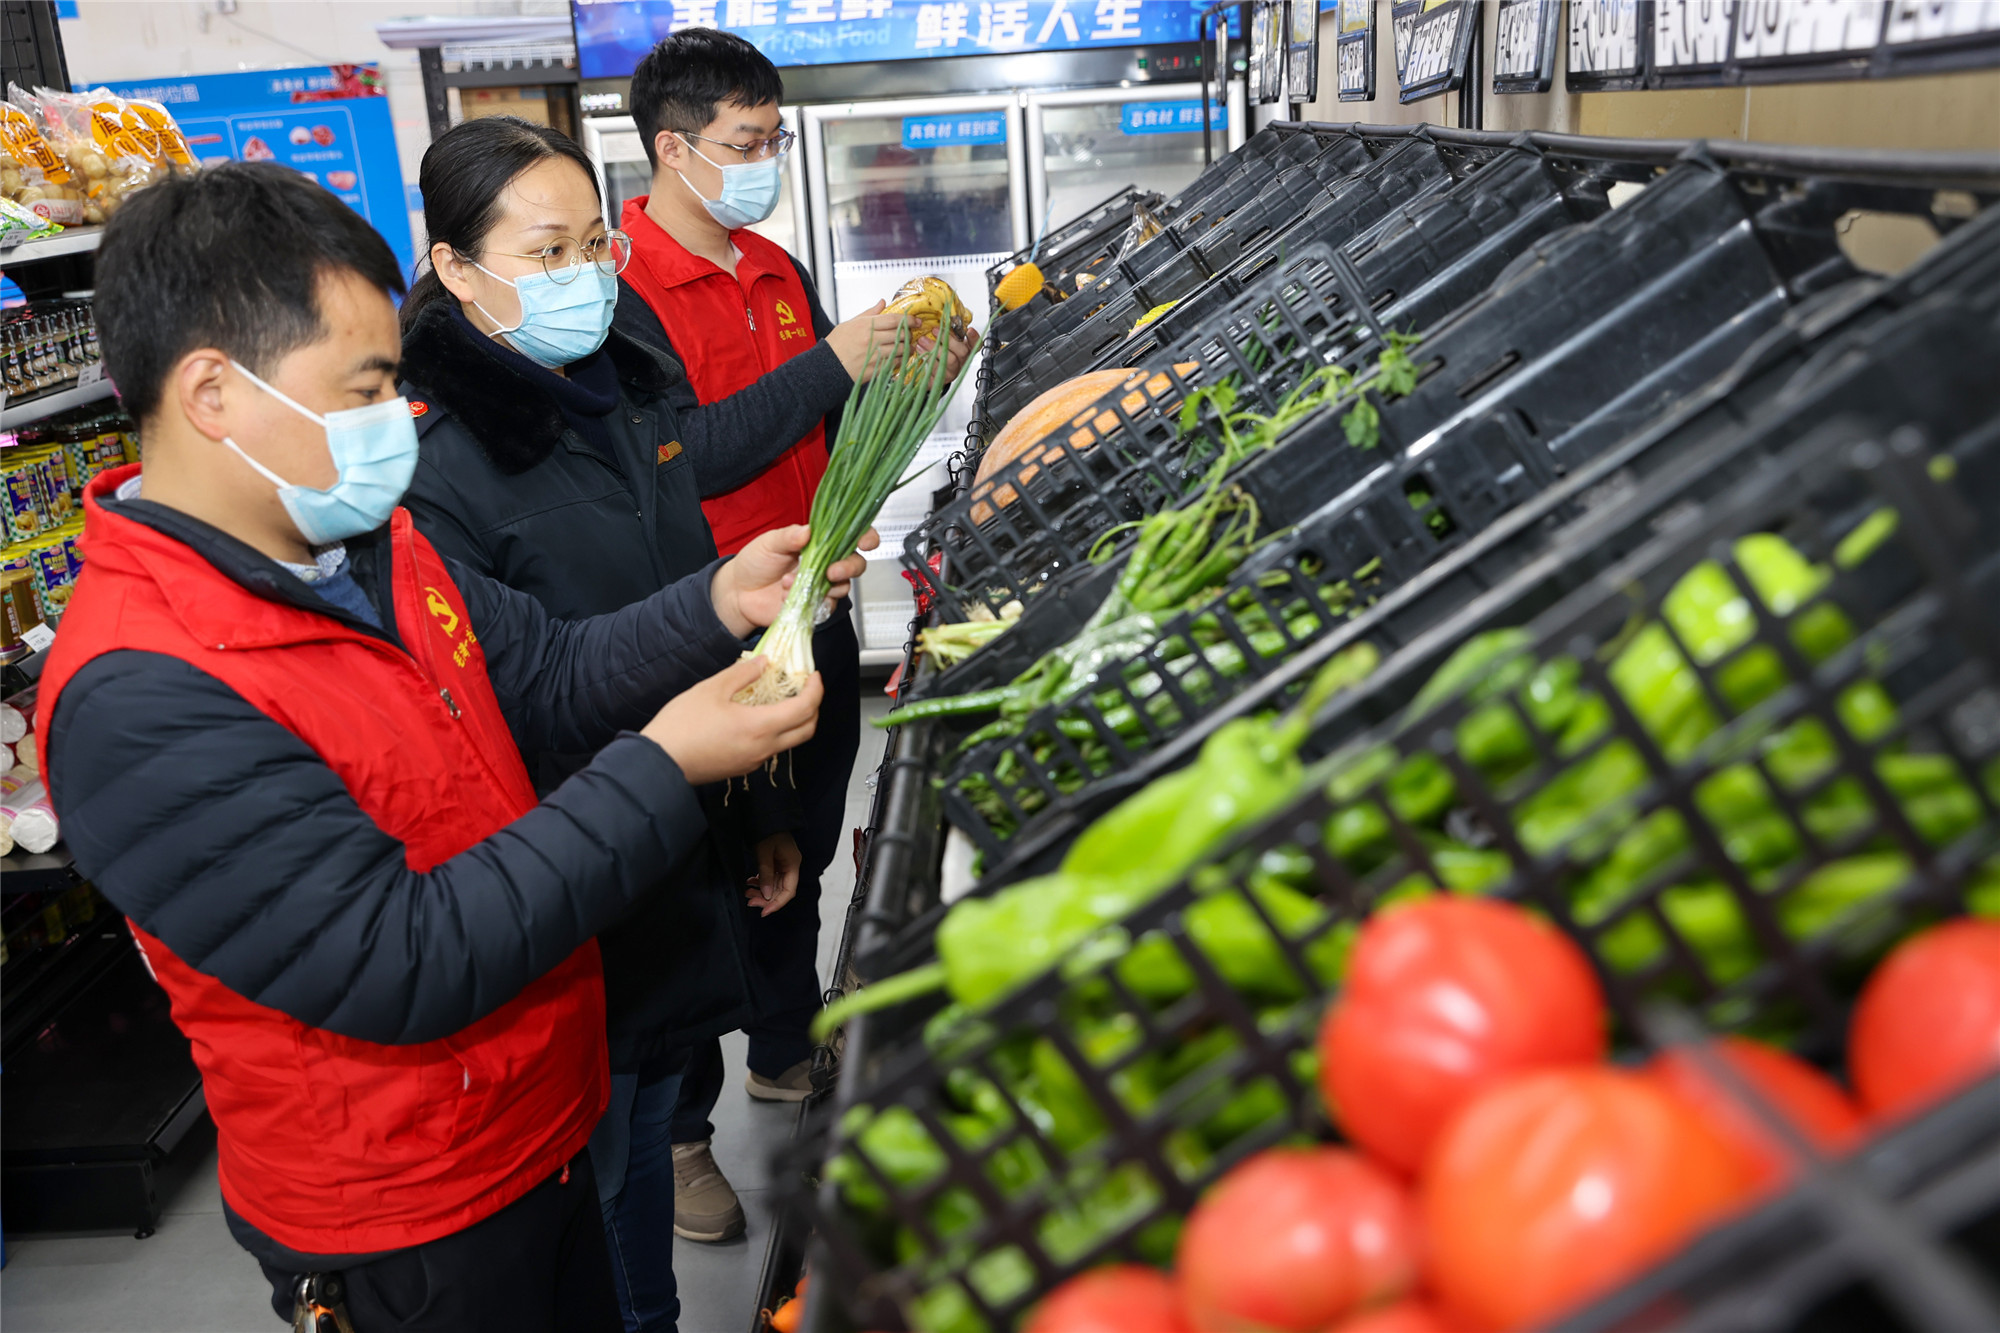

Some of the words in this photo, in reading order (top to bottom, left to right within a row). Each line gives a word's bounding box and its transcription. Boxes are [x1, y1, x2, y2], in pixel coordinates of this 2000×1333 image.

[837, 24, 891, 47] Food
[915, 0, 1141, 48] 鲜活人生
[909, 122, 952, 140] 真食材
[957, 119, 1000, 137] 鲜到家
